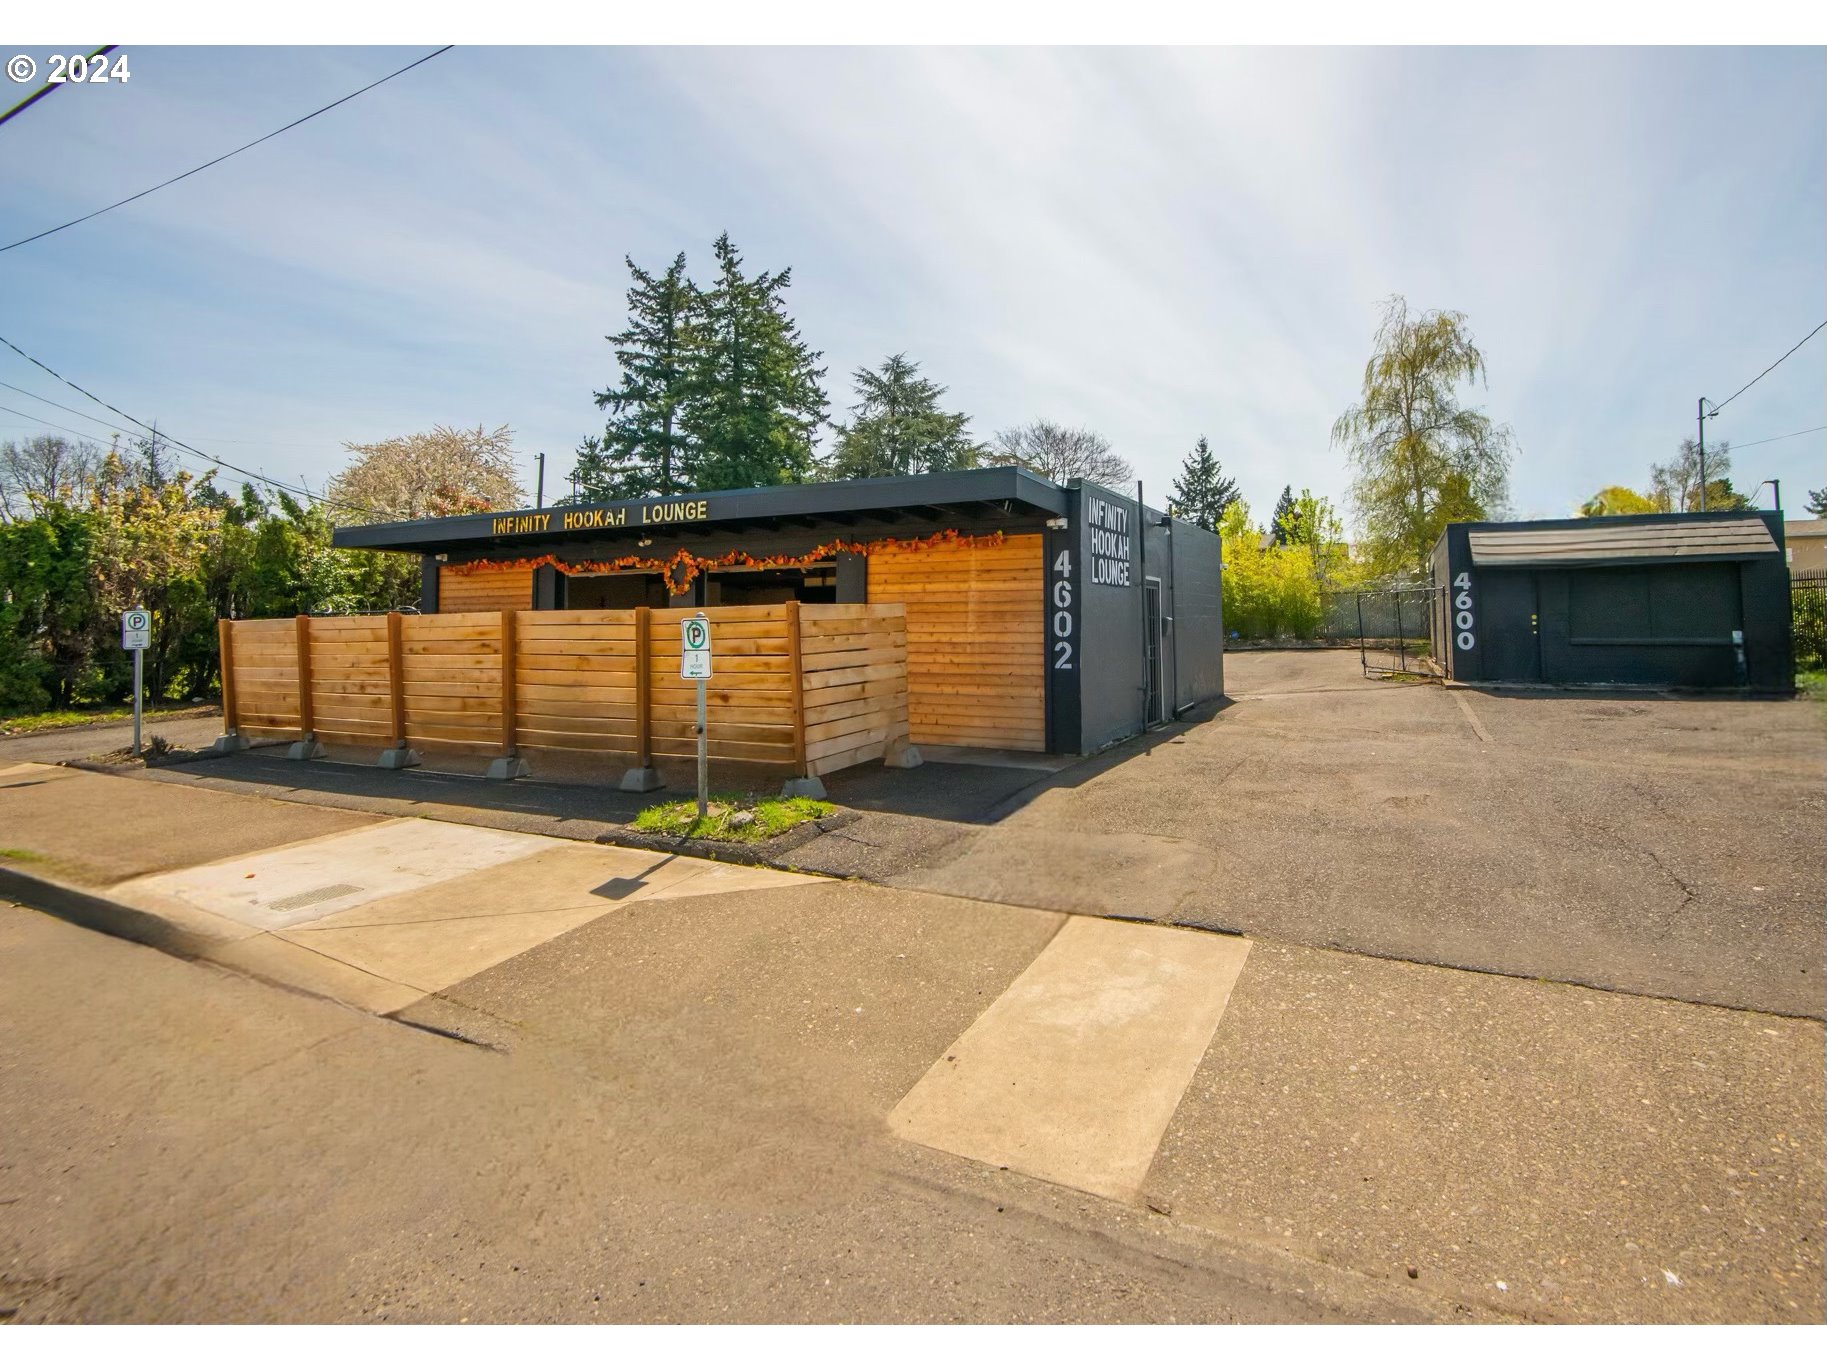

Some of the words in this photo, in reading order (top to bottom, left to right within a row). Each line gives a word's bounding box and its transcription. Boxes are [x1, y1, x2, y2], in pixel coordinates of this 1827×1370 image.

[492, 514, 551, 535] INFINITY
[564, 508, 626, 529] HOOKAH
[642, 501, 708, 524] LOUNGE
[1088, 496, 1129, 533] INFINITY
[1091, 527, 1130, 561] HOOKAH
[1091, 556, 1130, 586] LOUNGE
[133, 616, 142, 627] P
[1053, 550, 1073, 670] 4602
[1453, 572, 1476, 651] 4600
[691, 627, 701, 644] P
